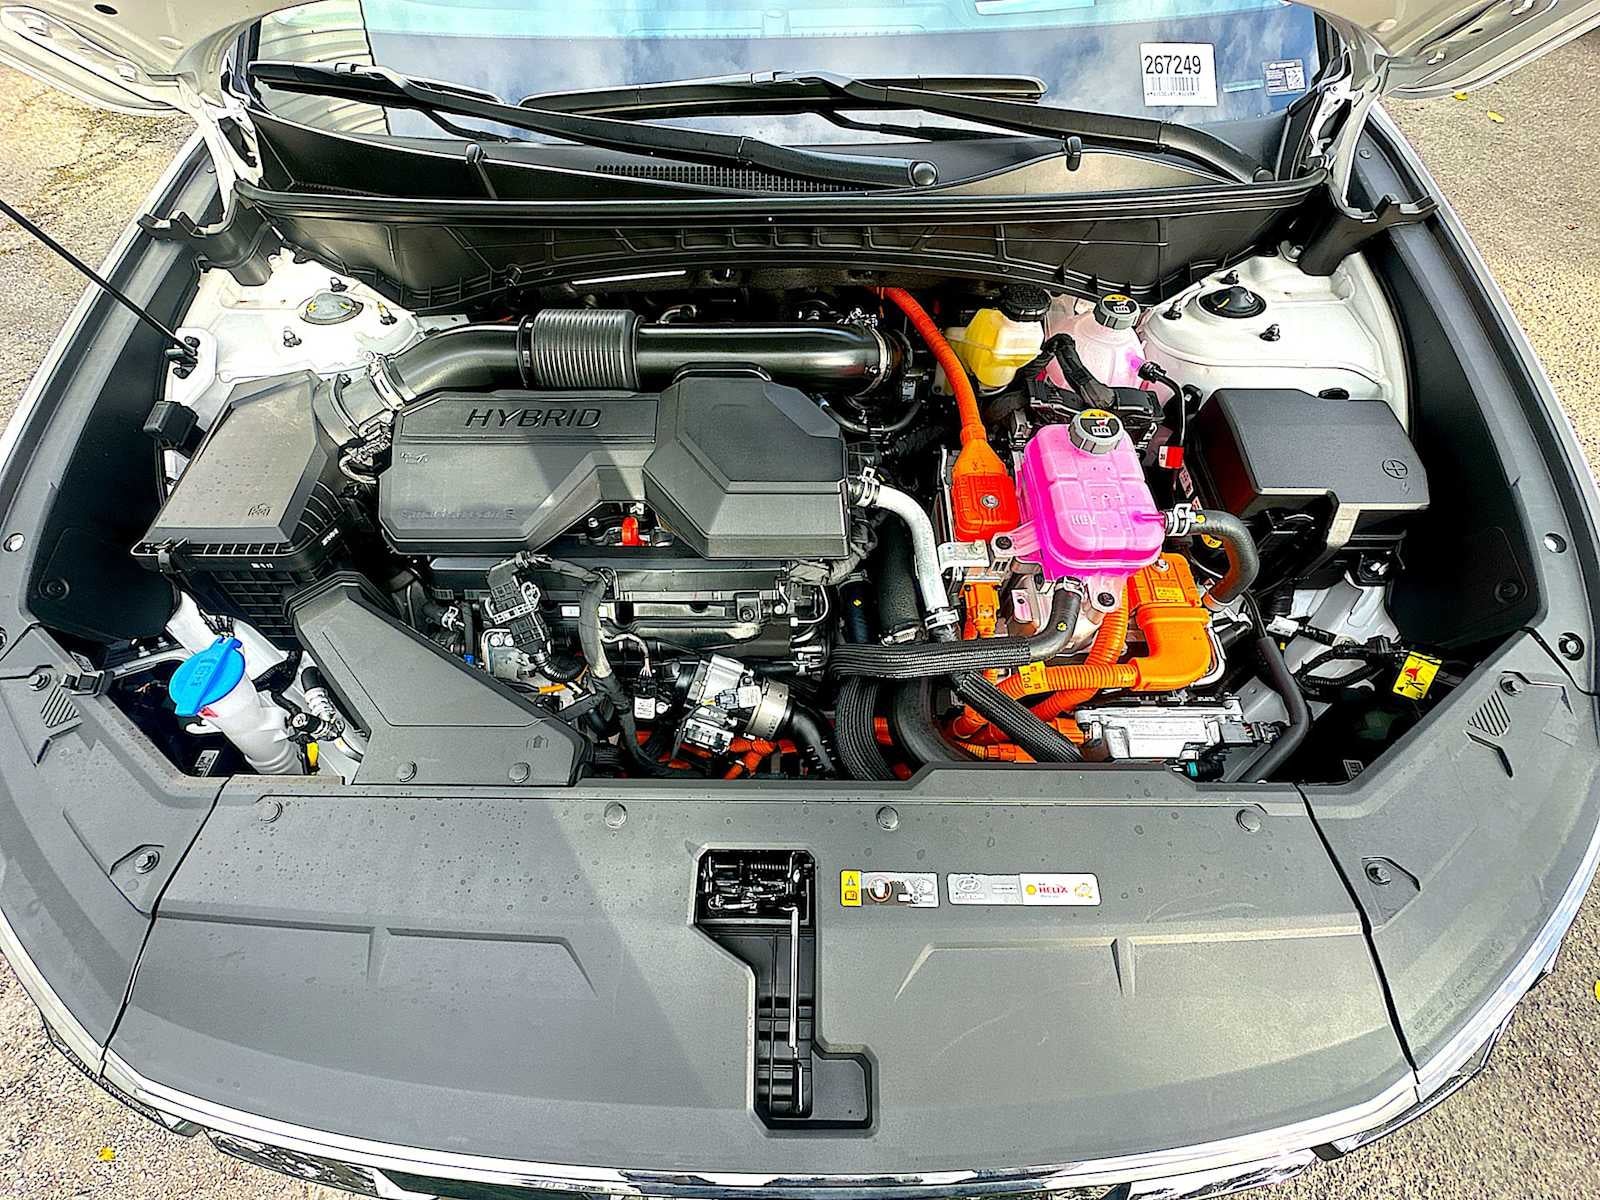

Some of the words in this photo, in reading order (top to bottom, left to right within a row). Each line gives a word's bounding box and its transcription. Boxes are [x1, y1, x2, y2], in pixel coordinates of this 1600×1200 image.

[1144, 55, 1201, 75] 267249
[464, 407, 602, 428] HYBRID
[1038, 886, 1069, 895] HELIX
